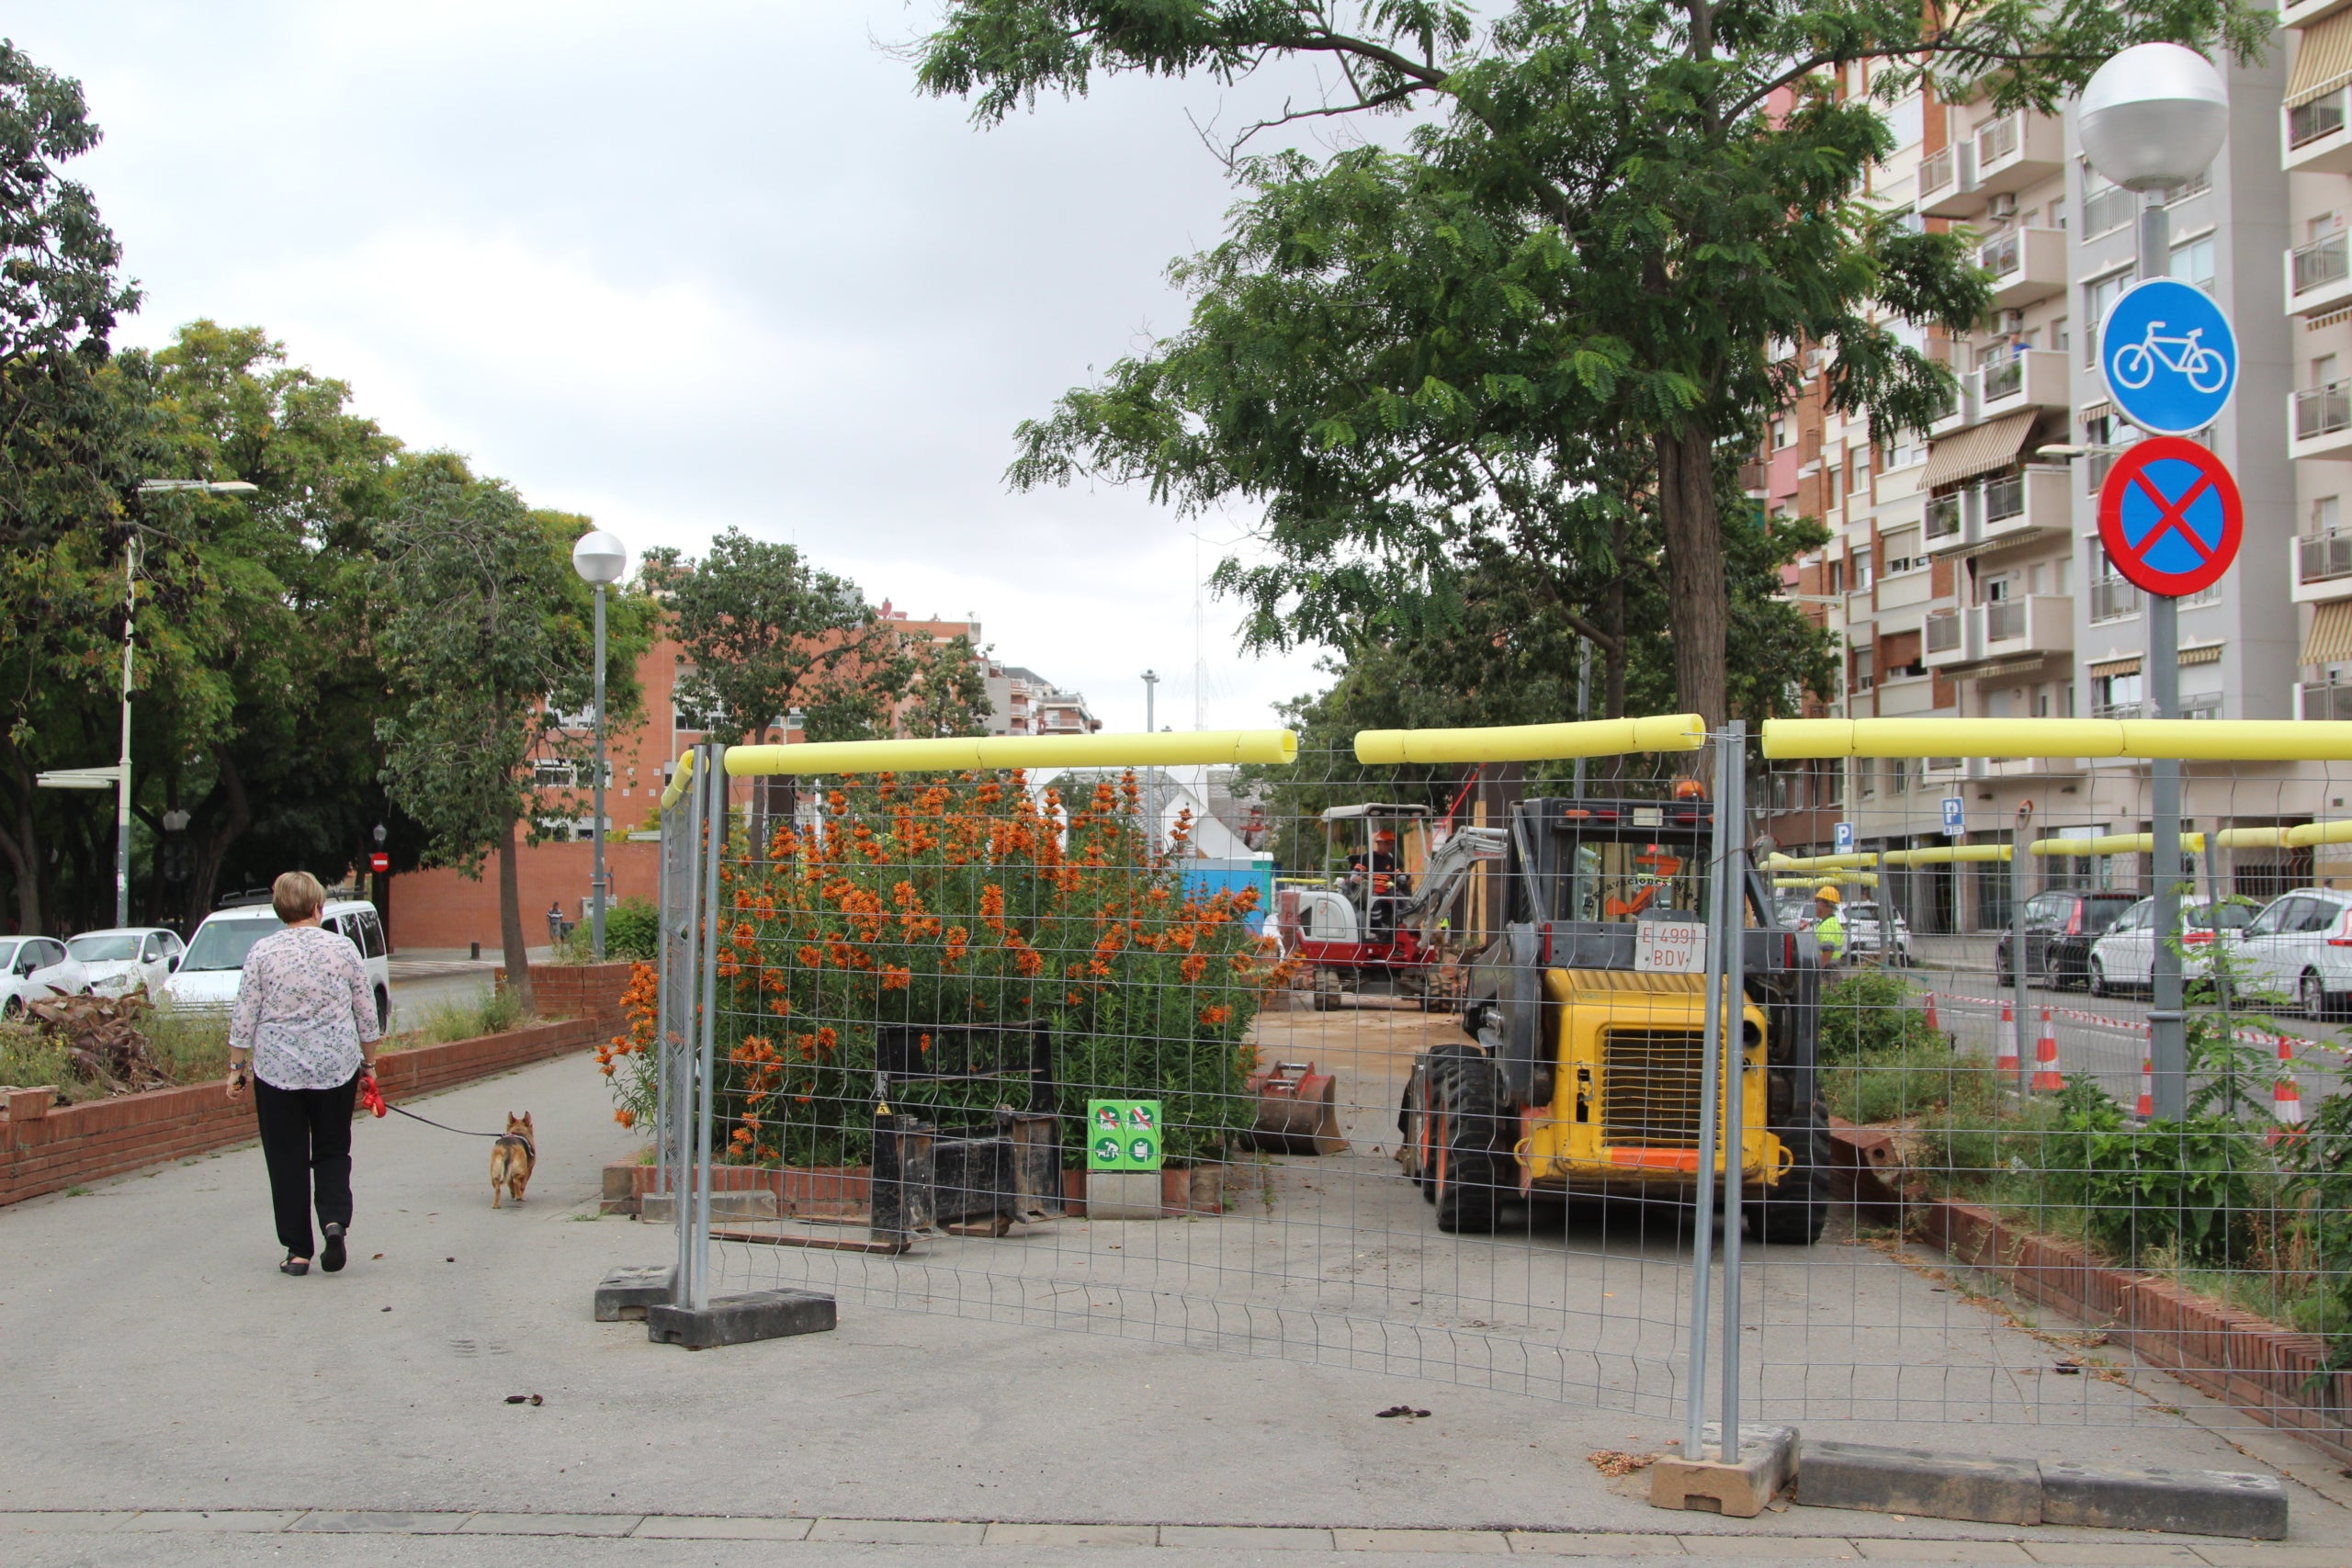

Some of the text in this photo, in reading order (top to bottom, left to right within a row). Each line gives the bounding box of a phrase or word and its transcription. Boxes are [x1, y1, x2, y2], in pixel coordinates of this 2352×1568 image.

[1945, 801, 1959, 824] P
[1838, 825, 1849, 844] P
[1643, 927, 1696, 945] E 4991
[1654, 949, 1686, 966] BDV
